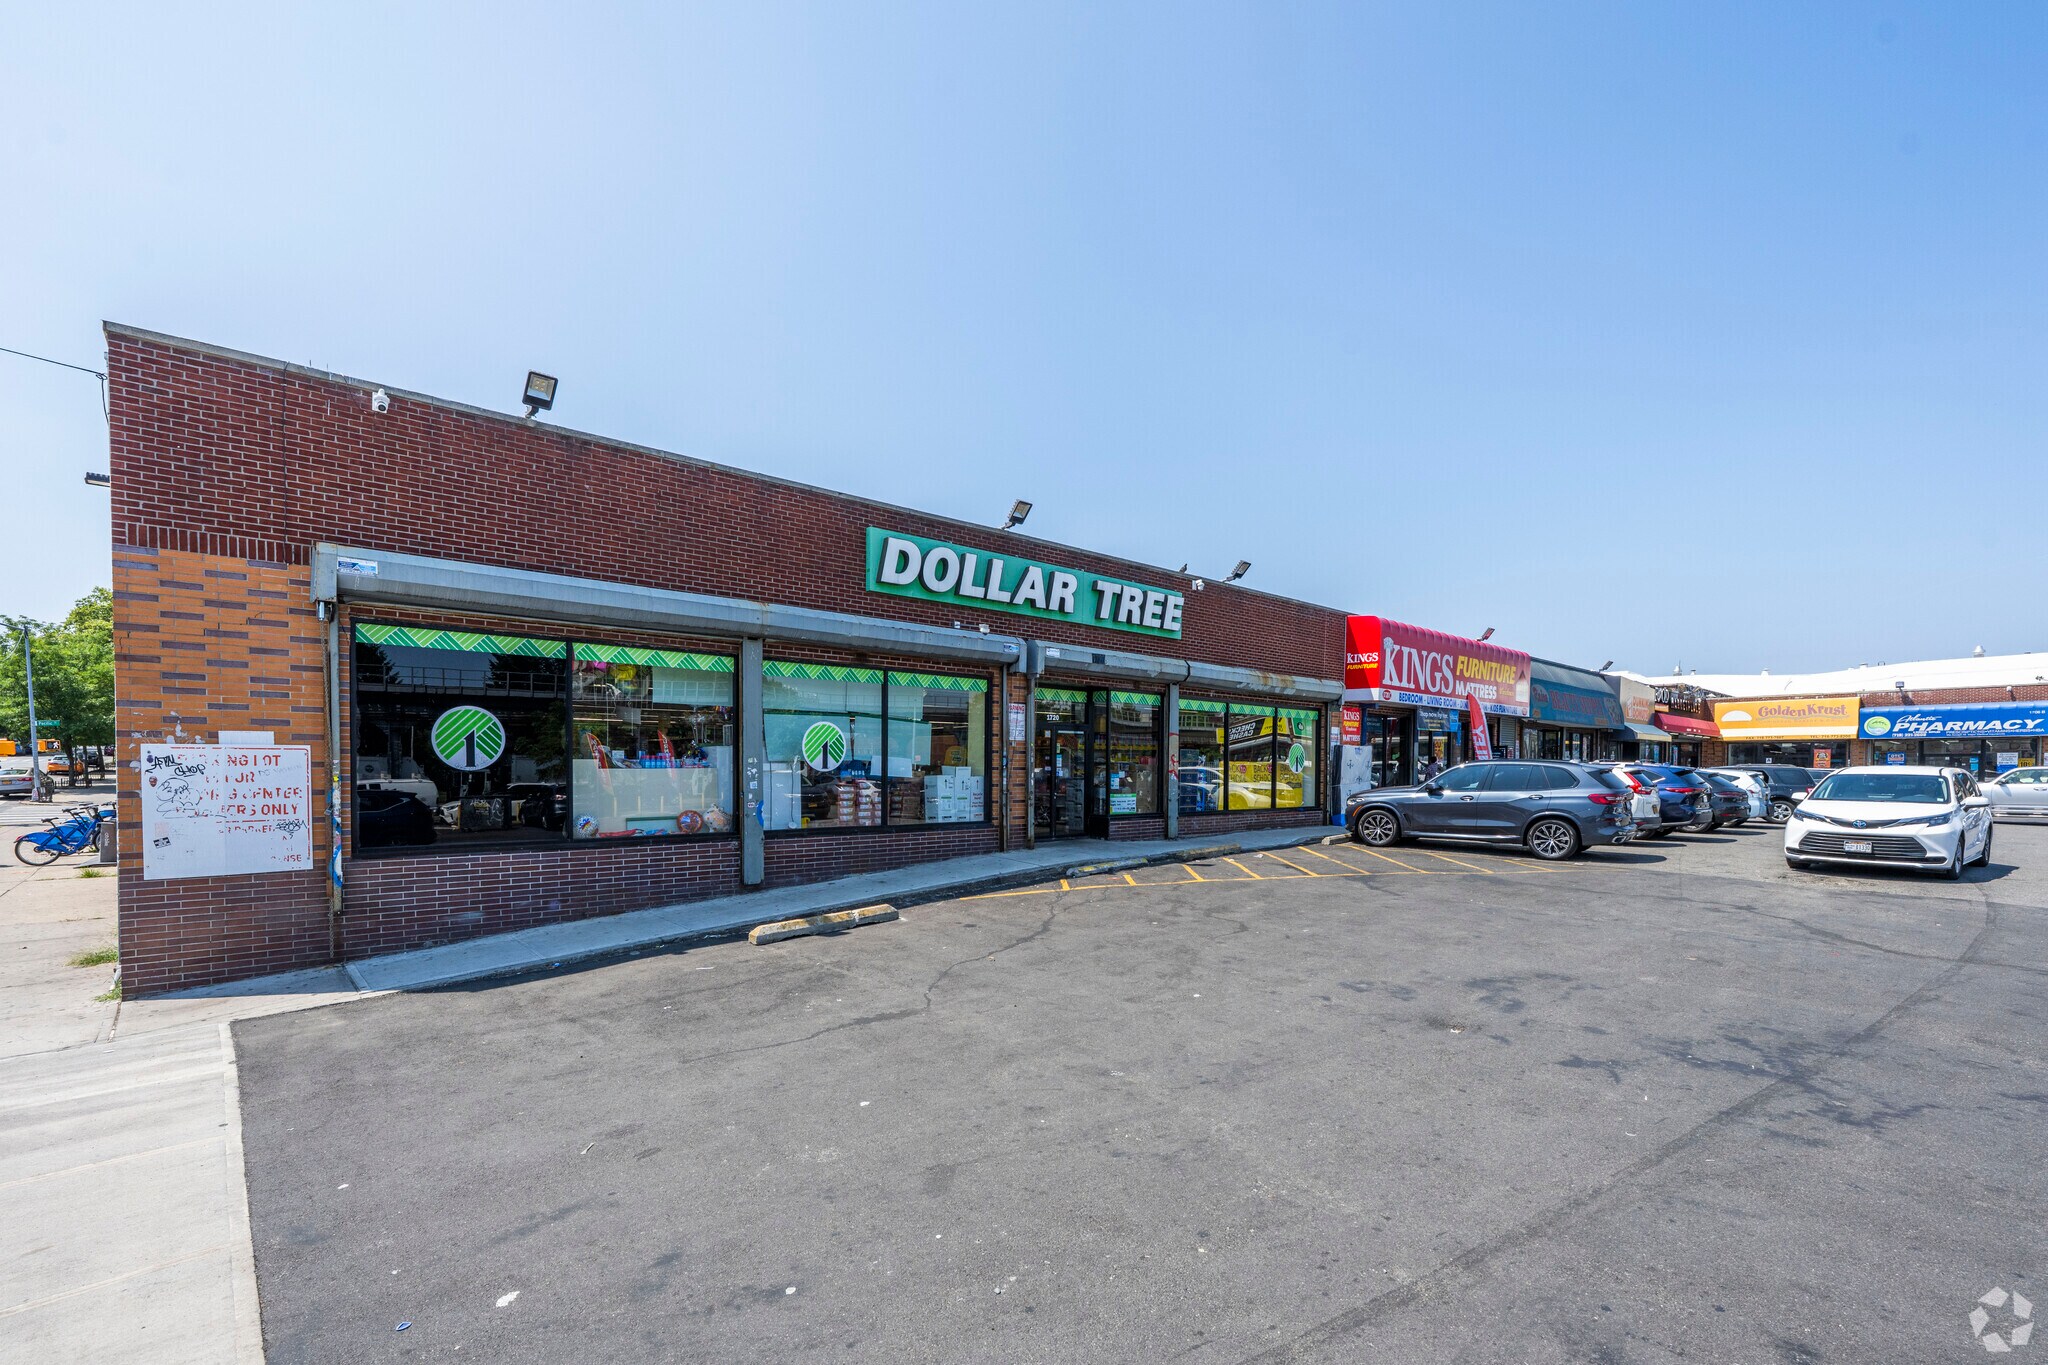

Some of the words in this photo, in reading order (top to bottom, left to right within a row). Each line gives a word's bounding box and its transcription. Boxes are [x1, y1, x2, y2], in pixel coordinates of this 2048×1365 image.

[876, 537, 1079, 614] DOLLAR
[1093, 579, 1185, 632] TREE
[1346, 652, 1379, 664] KINGS
[1382, 637, 1454, 694] KINGS
[1456, 655, 1517, 684] FURNITURE
[1455, 680, 1497, 700] MATTRESS
[1398, 692, 1423, 704] BEDROOM
[1426, 694, 1442, 707] LIVING
[1343, 710, 1360, 720] KINGS
[1757, 704, 1807, 717] Golden
[1806, 703, 1847, 716] Krust
[1892, 718, 2045, 732] PHARMACY
[1896, 713, 1942, 723] Atlantic
[1254, 774, 1272, 783] SCHOO
[261, 803, 299, 816] ONLY
